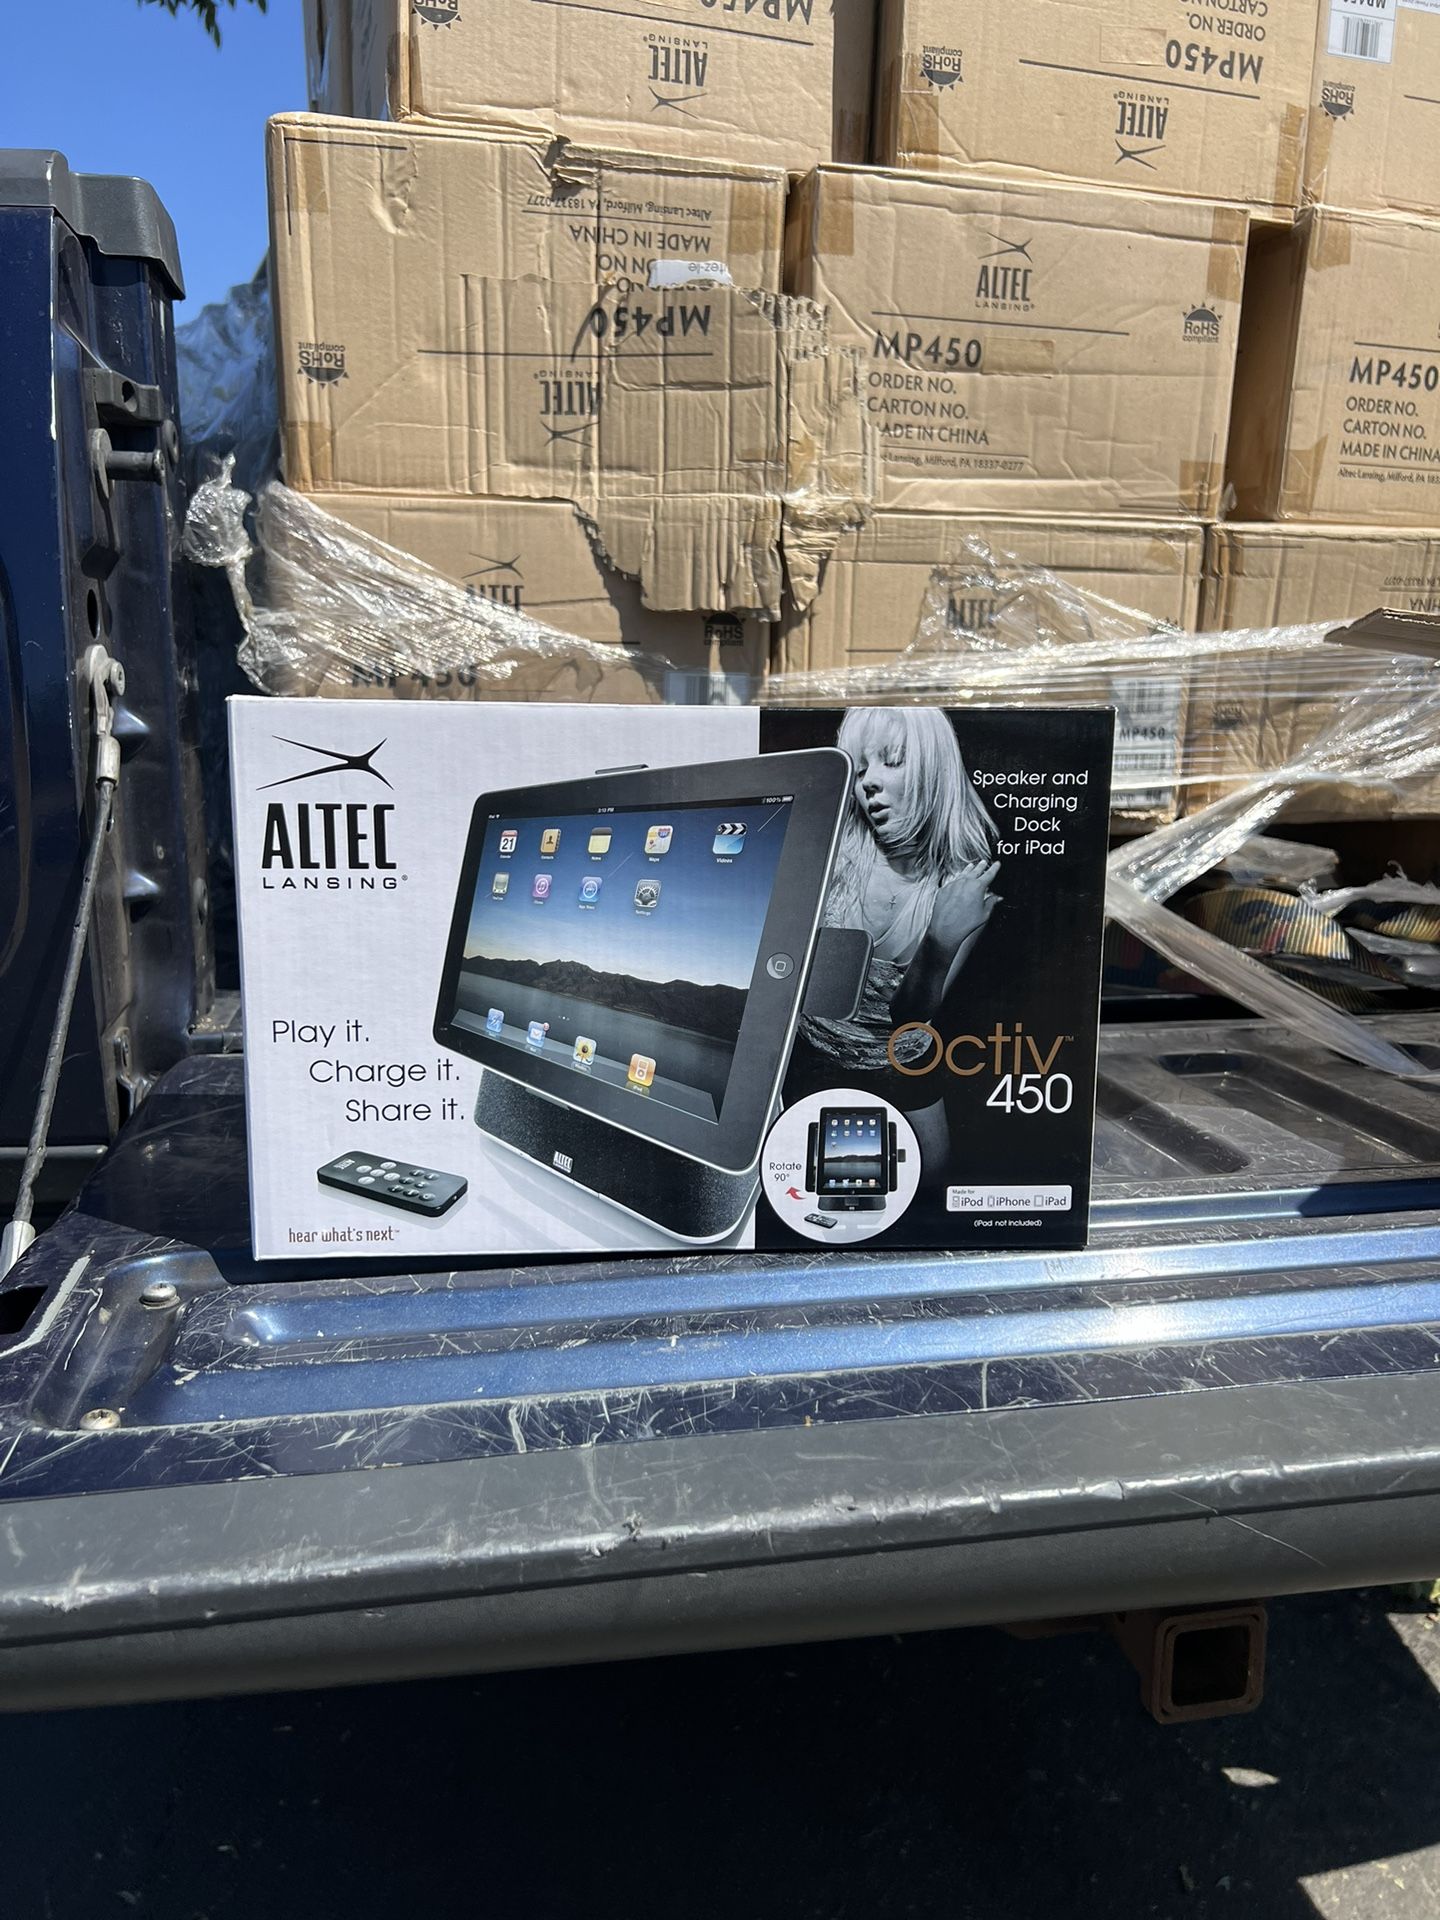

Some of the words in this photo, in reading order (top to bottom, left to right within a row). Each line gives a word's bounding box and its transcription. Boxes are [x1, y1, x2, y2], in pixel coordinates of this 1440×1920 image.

[1186, 12, 1213, 32] NO.
[1217, 18, 1266, 42] ORDER
[648, 44, 708, 87] ALTEC
[921, 53, 962, 73] RoHS
[1165, 39, 1264, 84] MP450
[1321, 87, 1354, 107] RoHS
[1115, 101, 1169, 140] ALTEC
[603, 197, 643, 214] Milford,
[645, 201, 684, 217] Lansing,
[687, 207, 712, 221] Altec
[569, 224, 629, 246] CHINA
[634, 231, 652, 248] IN
[658, 232, 711, 254] MADE
[688, 262, 725, 275] tez-le
[976, 264, 1033, 302] ALTEC
[590, 305, 711, 339] MP450
[1184, 321, 1220, 336] RoHS
[873, 330, 982, 368] MP450
[1182, 334, 1219, 344] compliant
[299, 350, 345, 368] RoHS
[868, 372, 923, 392] ORDER
[927, 377, 957, 395] NO.
[1349, 356, 1439, 392] MP450
[867, 397, 936, 416] CARTON
[940, 403, 969, 420] NO.
[1346, 396, 1391, 414] ORDER
[1394, 401, 1419, 417] NO.
[917, 427, 934, 442] IN
[937, 427, 990, 446] CHINA
[1343, 419, 1400, 437] CARTON
[1403, 423, 1427, 440] NO.
[1339, 441, 1380, 457] MADE
[1382, 444, 1397, 459] IN
[1400, 446, 1440, 462] CHINA
[704, 625, 744, 639] RoHS
[1119, 727, 1166, 741] MP450
[972, 770, 1047, 788] Speaker
[1052, 770, 1089, 785] and
[993, 793, 1078, 812] Charging
[1014, 817, 1061, 832] Dock
[261, 803, 397, 869] ALTEC
[501, 838, 515, 850] 21
[996, 840, 1020, 855] for
[1025, 840, 1065, 855] iPad
[272, 1020, 336, 1048] Play
[346, 1020, 370, 1043] it.
[309, 1059, 427, 1087] Charge
[436, 1058, 460, 1081] it.
[985, 1072, 1074, 1114] 450
[345, 1099, 432, 1122] Share
[441, 1098, 465, 1120] it.
[769, 1162, 802, 1171] Rotate
[961, 1196, 984, 1207] iPod
[995, 1196, 1031, 1207] iPhone
[1045, 1196, 1067, 1206] iPad
[994, 1219, 1007, 1227] not
[1008, 1219, 1042, 1227] included)
[288, 1227, 318, 1243] hear
[321, 1226, 363, 1242] what's
